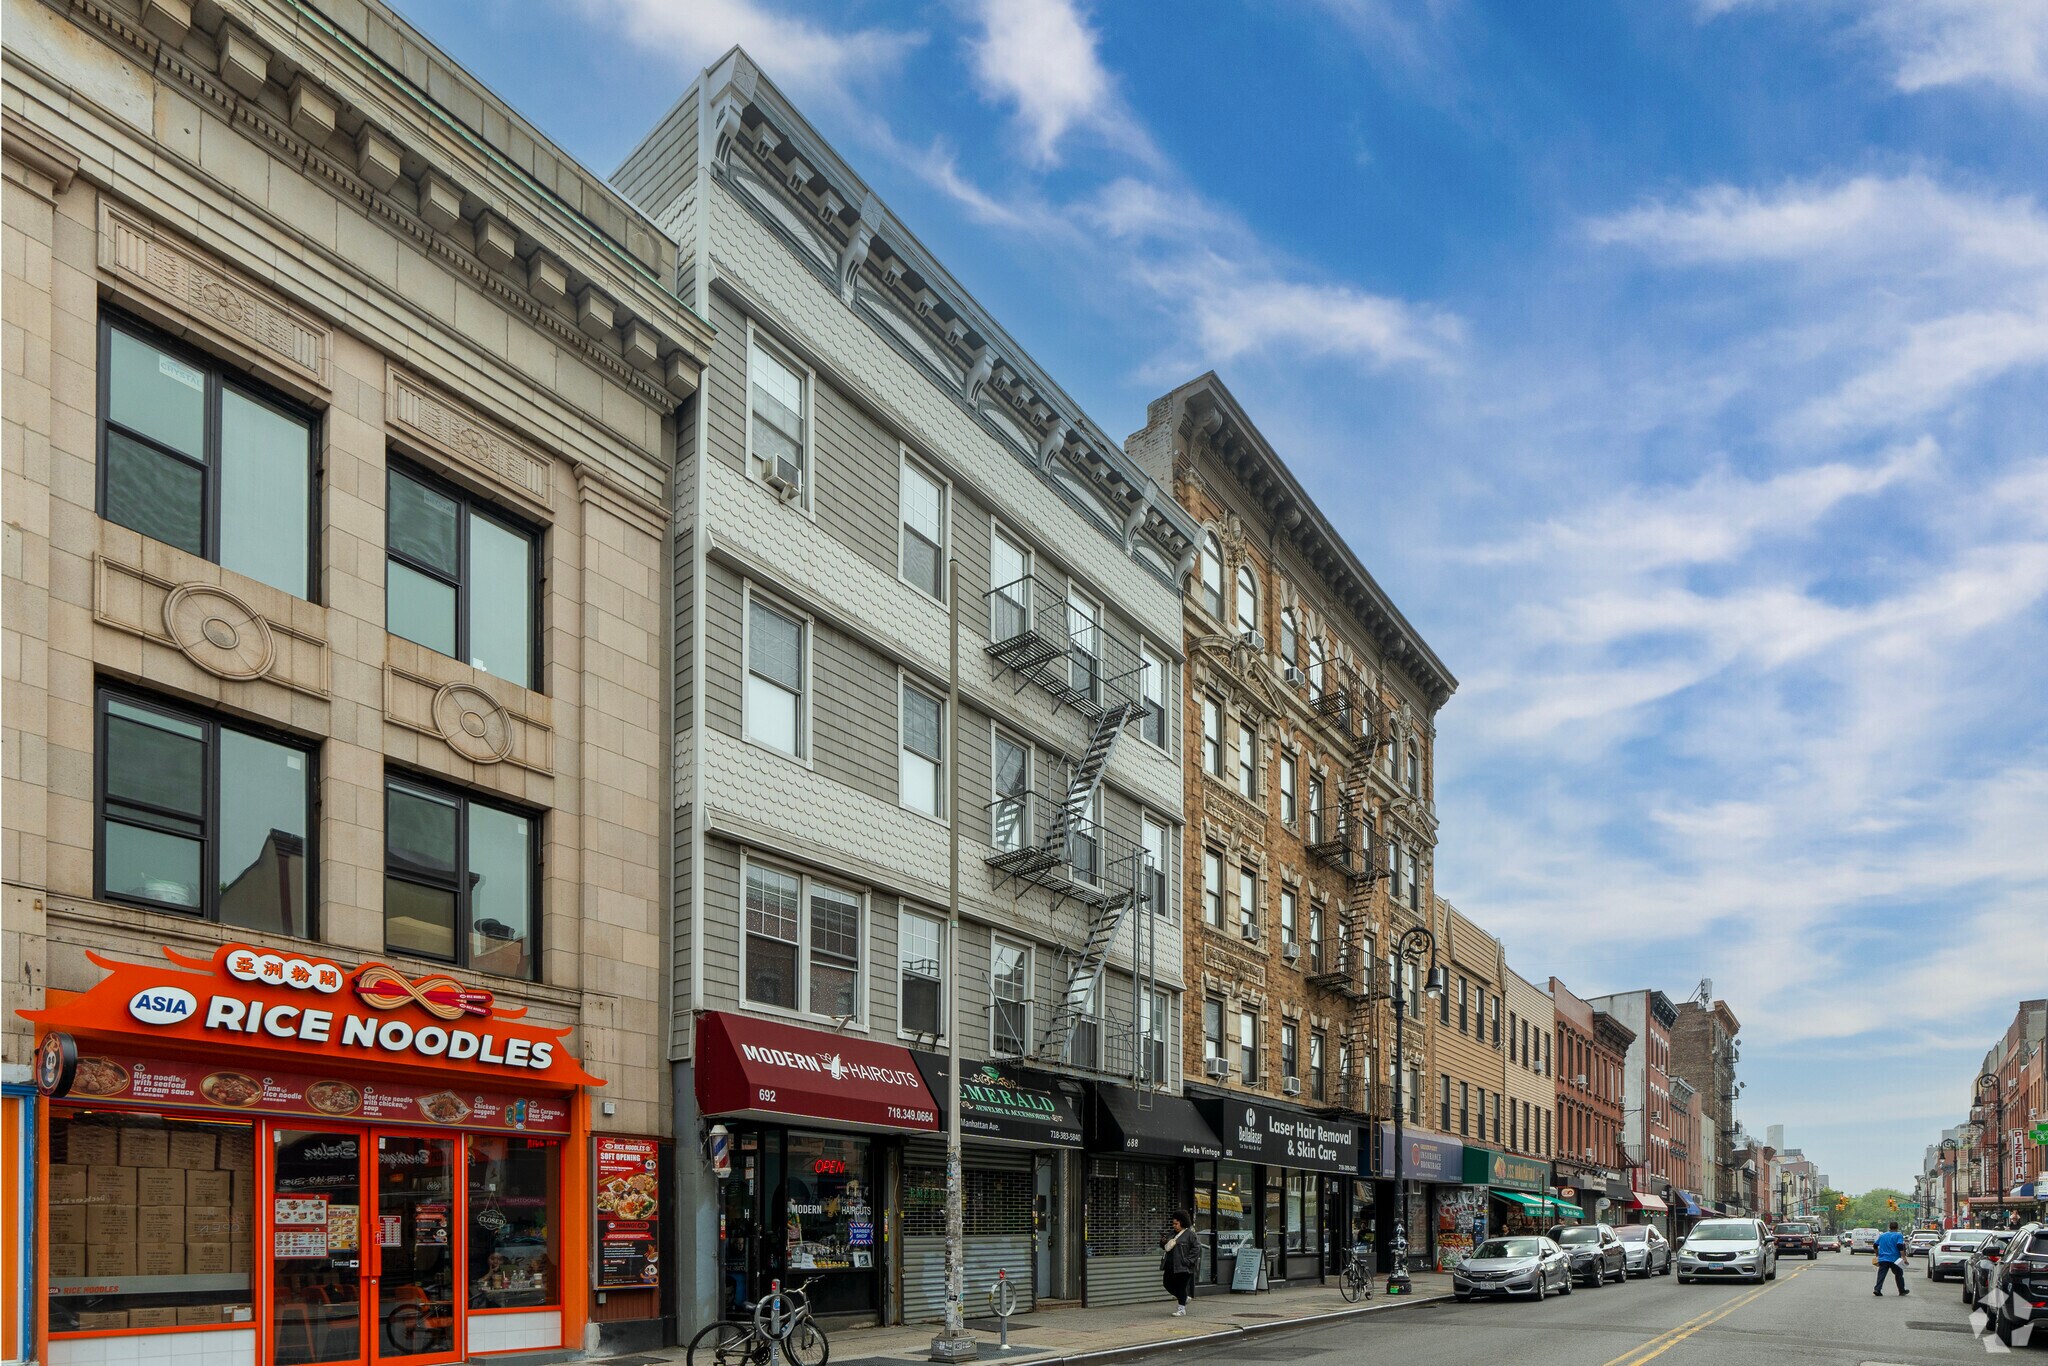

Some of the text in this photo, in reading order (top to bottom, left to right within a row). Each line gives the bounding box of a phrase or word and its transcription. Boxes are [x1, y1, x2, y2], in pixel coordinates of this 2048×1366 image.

[135, 995, 187, 1015] ASIA
[205, 995, 554, 1069] RICE NOODLES
[741, 1044, 919, 1088] MODERN HAIRCUTS
[134, 1072, 180, 1082] Rice noodle
[134, 1079, 186, 1089] with seafood
[170, 1088, 194, 1096] sauce
[278, 1092, 302, 1100] noodle
[759, 1089, 776, 1102] 692
[960, 1083, 1055, 1112] EMERALD
[379, 1100, 402, 1108] chicken
[888, 1106, 934, 1122] 718.349.0664
[975, 1104, 1004, 1115] JEWELRY
[1010, 1109, 1050, 1121] ACCESSORIES
[1269, 1116, 1352, 1145] Laser Hair Removal
[1126, 1138, 1139, 1148] 688
[600, 1152, 615, 1160] SOFT
[616, 1154, 640, 1162] OPENING
[1182, 1145, 1220, 1158] Awoke Vintage
[1288, 1140, 1337, 1161] & Skin Care
[2014, 1131, 2024, 1180] PIZZERIA
[814, 1160, 845, 1174] OPEN
[791, 1204, 872, 1216] MODERN HAIRCUTS
[479, 1216, 504, 1224] CLOSED
